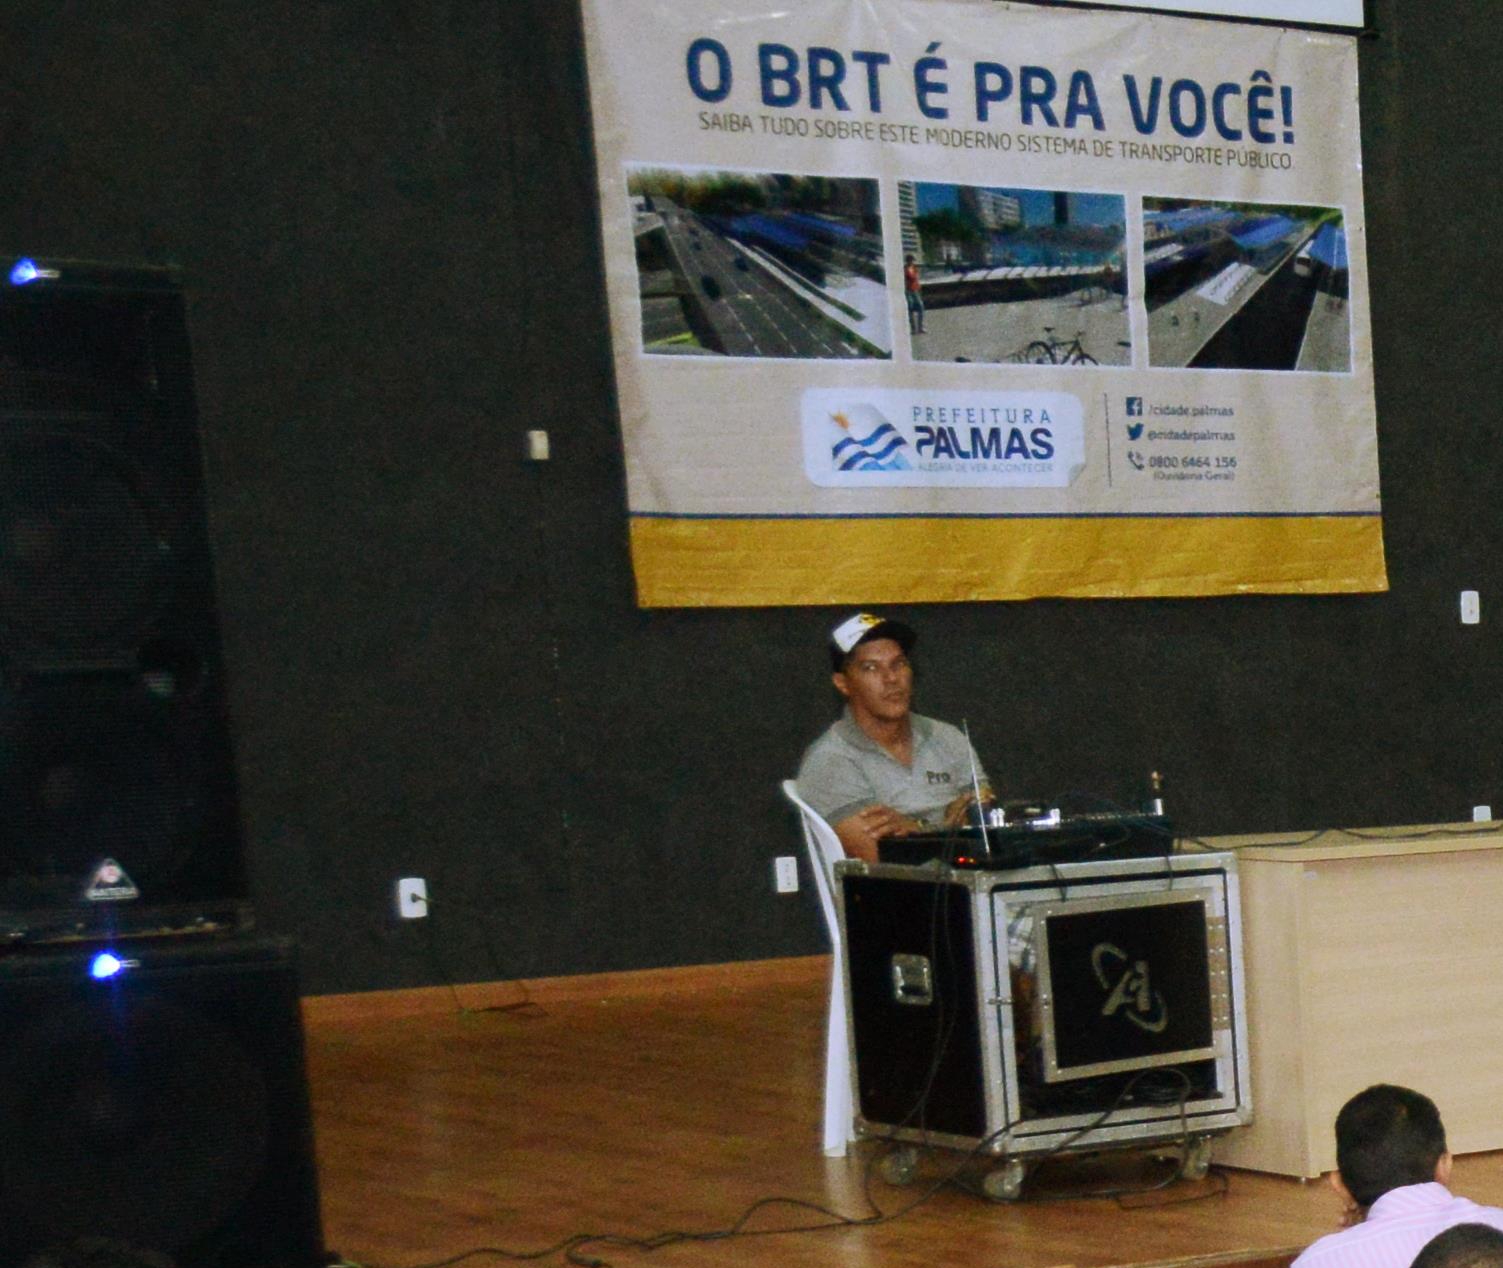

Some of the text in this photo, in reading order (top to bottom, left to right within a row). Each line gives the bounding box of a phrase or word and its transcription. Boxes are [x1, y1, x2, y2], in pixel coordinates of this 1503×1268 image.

[686, 37, 1295, 145] O BRT É PRA VOCÊ!
[699, 111, 1292, 170] SAIBA TUDO SOBRE ESTE MODERNO SISTEMA DE TRANSPORTE PÚBLICO
[912, 405, 1053, 424] PREFEITURA
[914, 425, 1055, 460] PALMAS
[1149, 456, 1179, 468] 0800
[1215, 456, 1238, 468] 156
